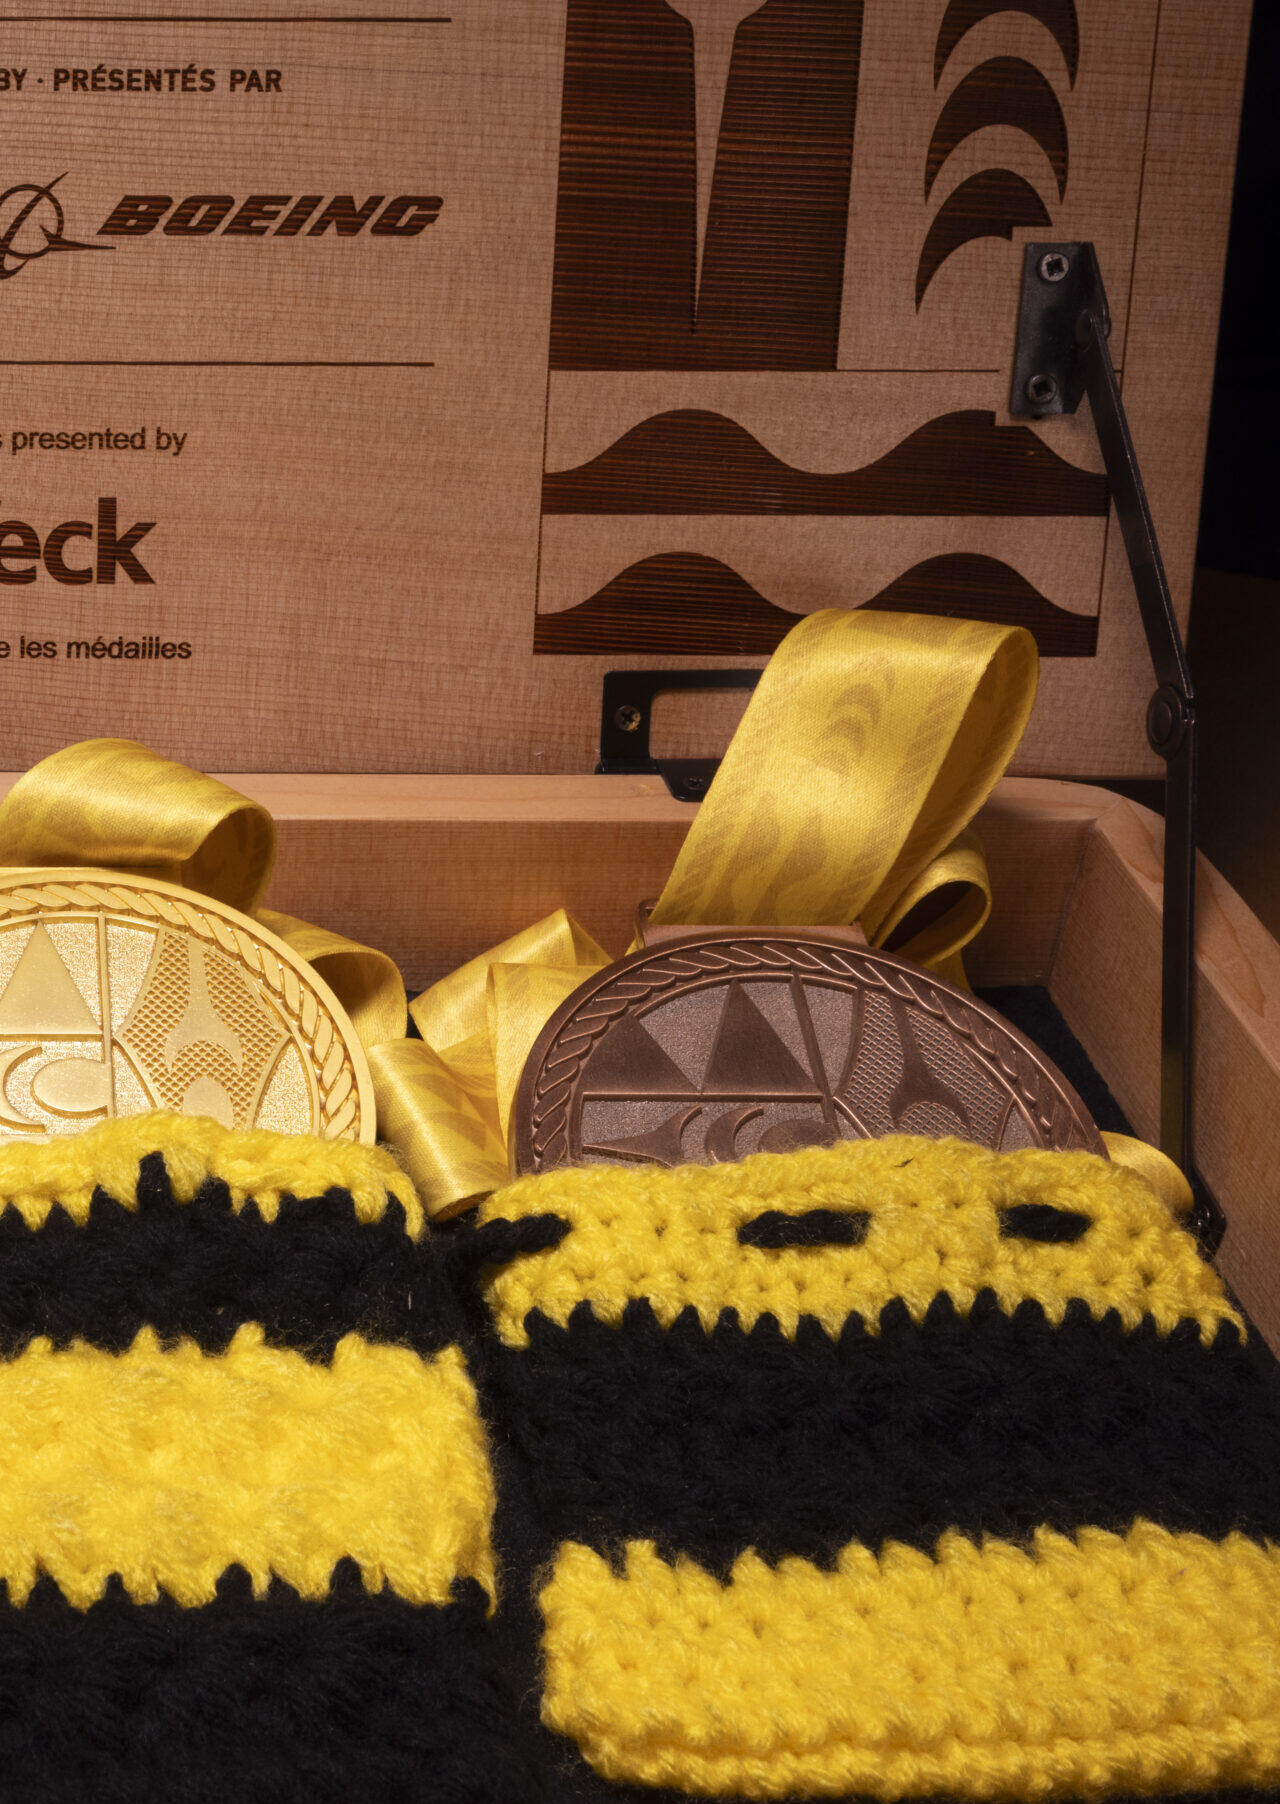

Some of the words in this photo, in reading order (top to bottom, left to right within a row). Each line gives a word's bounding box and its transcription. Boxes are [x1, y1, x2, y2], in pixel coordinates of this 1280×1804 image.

[53, 64, 216, 93] PRÉSENTÉS
[229, 69, 283, 93] PAR
[97, 194, 444, 237] BOEING
[11, 426, 147, 456] presented
[155, 426, 188, 457] by
[19, 635, 58, 660] les
[66, 635, 193, 660] médailles
